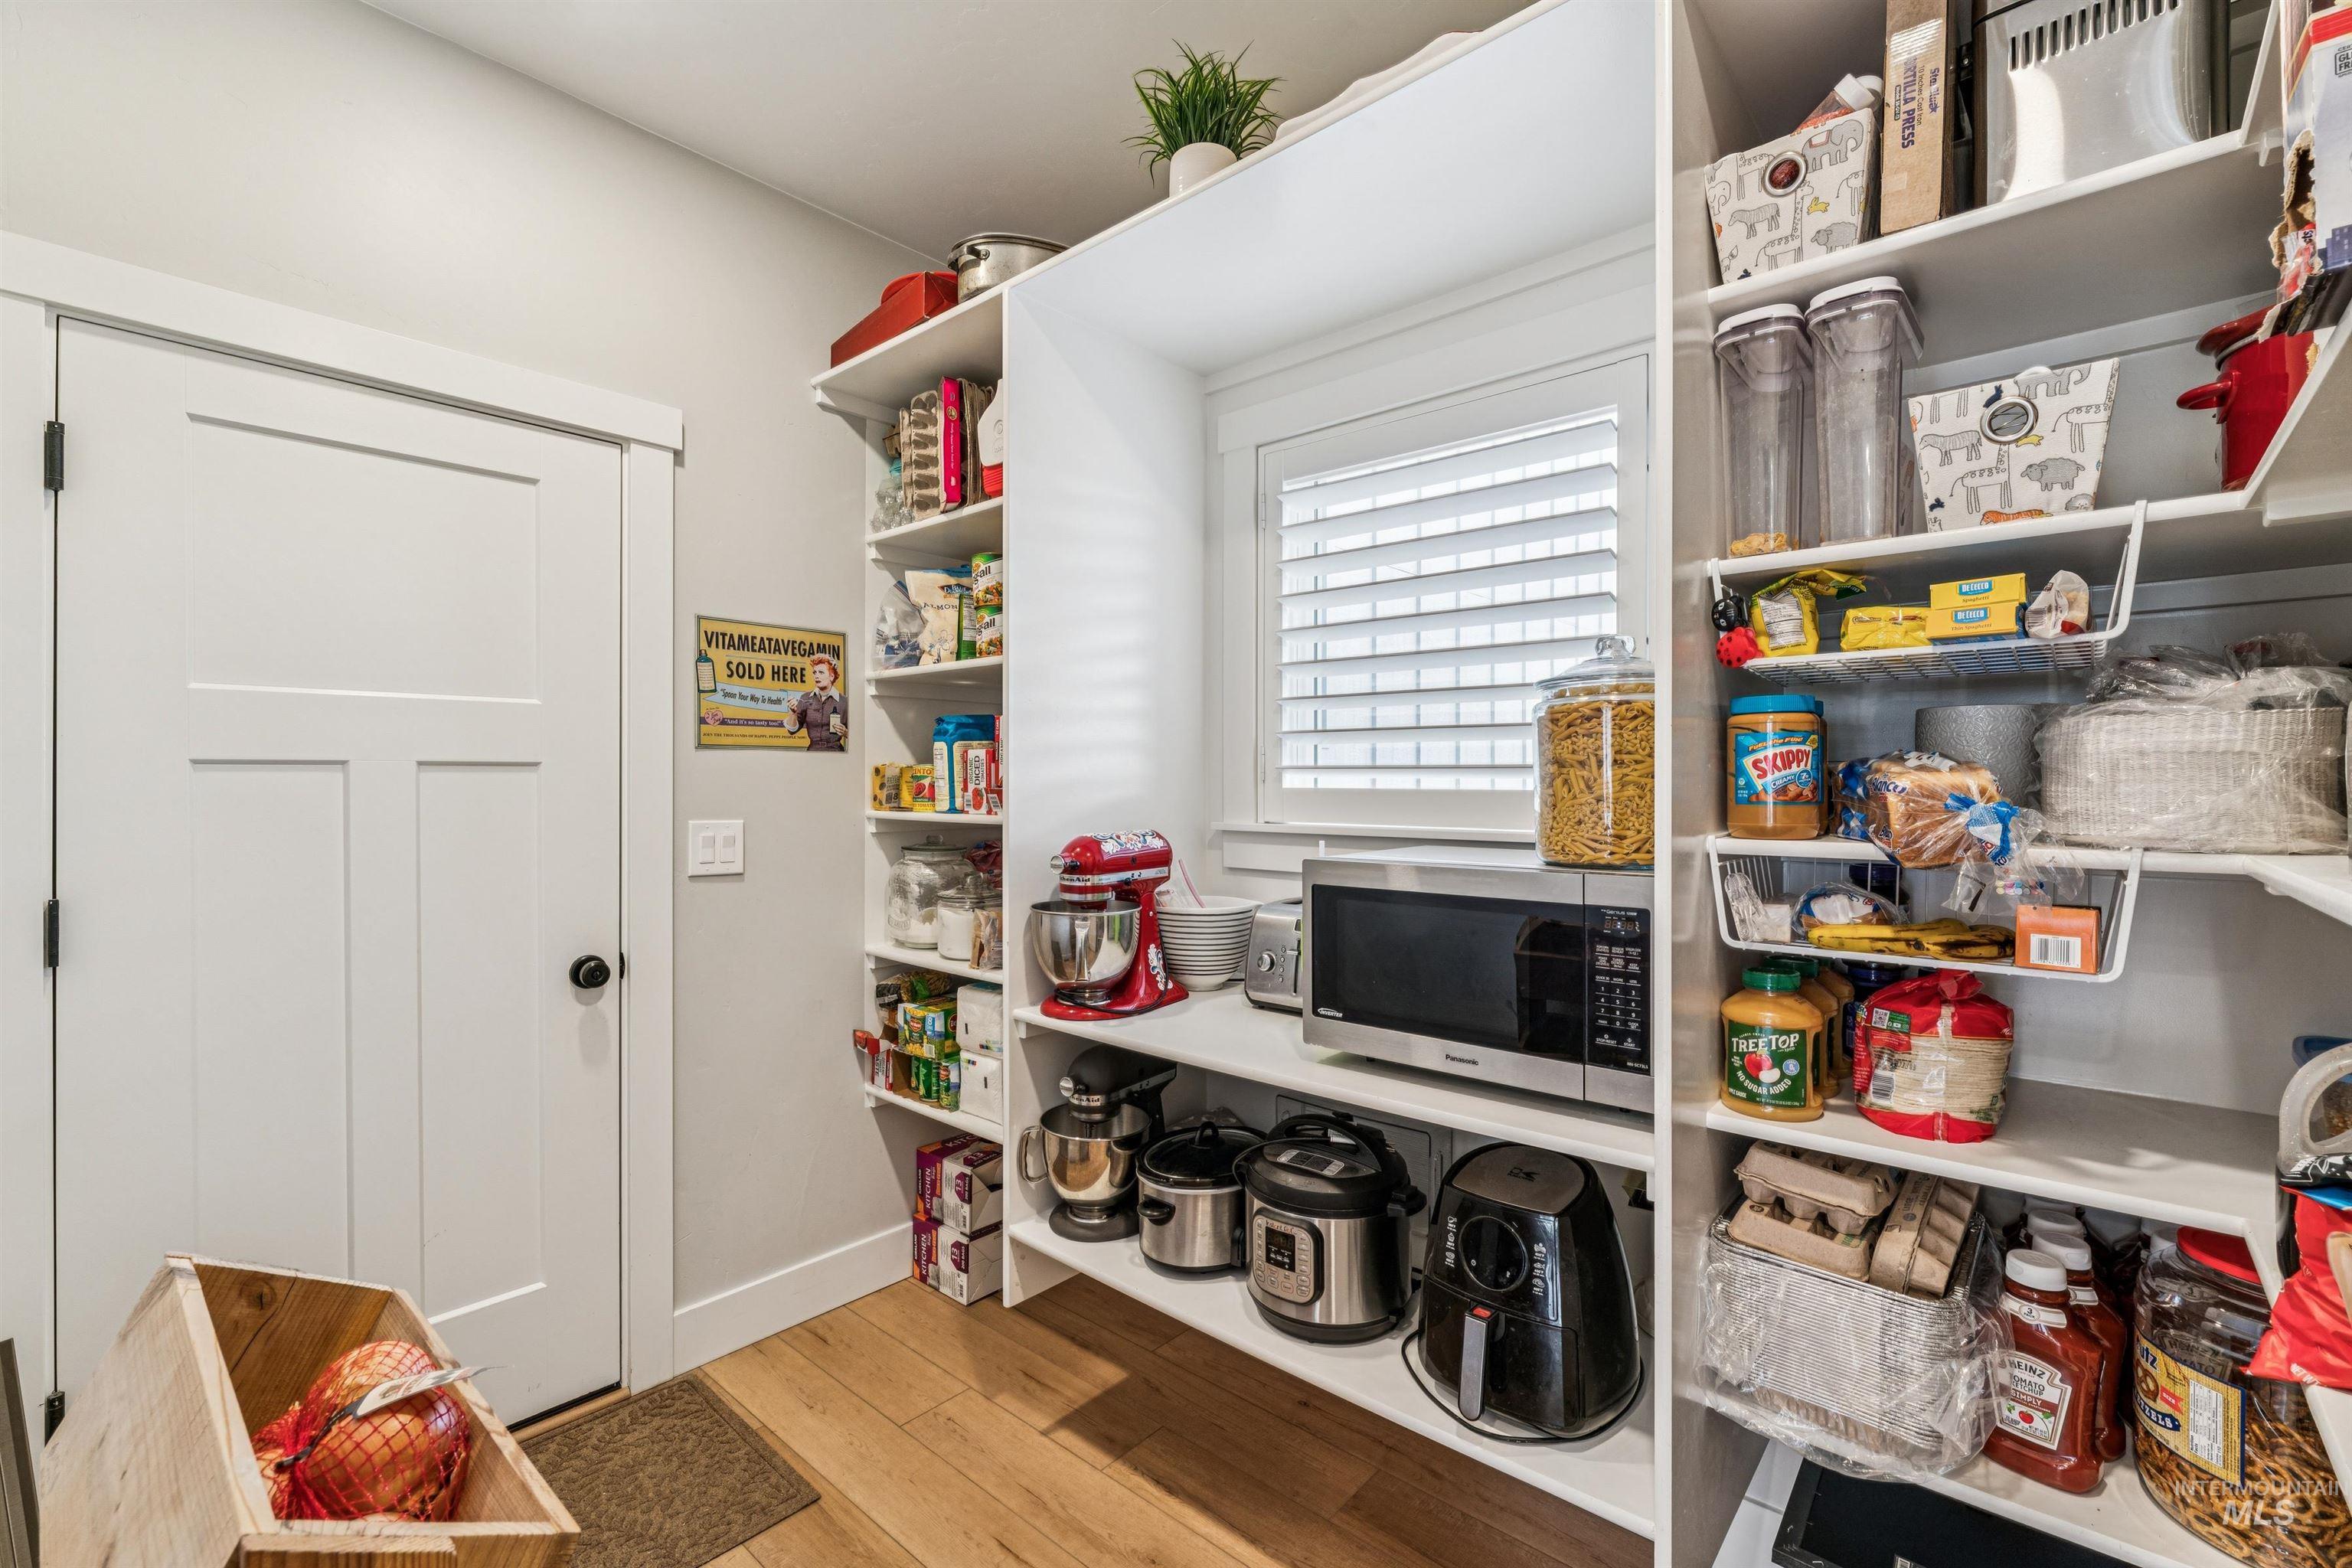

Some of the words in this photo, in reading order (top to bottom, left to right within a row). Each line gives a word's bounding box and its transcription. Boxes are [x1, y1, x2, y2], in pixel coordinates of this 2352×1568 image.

[1918, 65, 1925, 74] 10
[1903, 57, 1917, 106] ORTILLA
[1917, 74, 1926, 96] Inches
[1901, 108, 1916, 149] PRESS
[923, 602, 959, 611] ALMON
[1962, 595, 1990, 603] Spaghetti
[1965, 622, 1992, 631] Spaghetti
[704, 630, 841, 660] VITAMEATAVEGAMIN
[727, 661, 765, 681] SOLD
[771, 665, 806, 684] HERE
[720, 688, 737, 699] "Spoon
[738, 691, 750, 701] Your
[750, 694, 760, 704] Way
[761, 695, 766, 704] To
[766, 696, 785, 705] Health"
[1751, 748, 1811, 780] SKIPPY
[1771, 774, 1795, 789] CREAMY
[1872, 776, 1907, 794] Blanco
[927, 1017, 933, 1025] 8
[1732, 1037, 1768, 1052] TREE
[1769, 1033, 1799, 1050] TOP
[1445, 1054, 1479, 1066] Panasonic
[1736, 1070, 1746, 1081] NO
[1743, 1080, 1768, 1095] SUGAR
[1769, 1078, 1792, 1095] ADDED
[1736, 1090, 1746, 1099] SAUCE
[956, 1178, 962, 1191] 13
[951, 1247, 958, 1260] 13
[2008, 1358, 2046, 1380] HEINZ
[2011, 1390, 2042, 1406] SIMPLY
[2162, 1392, 2176, 1405] SIZE
[2135, 1393, 2173, 1429] ETZELS
